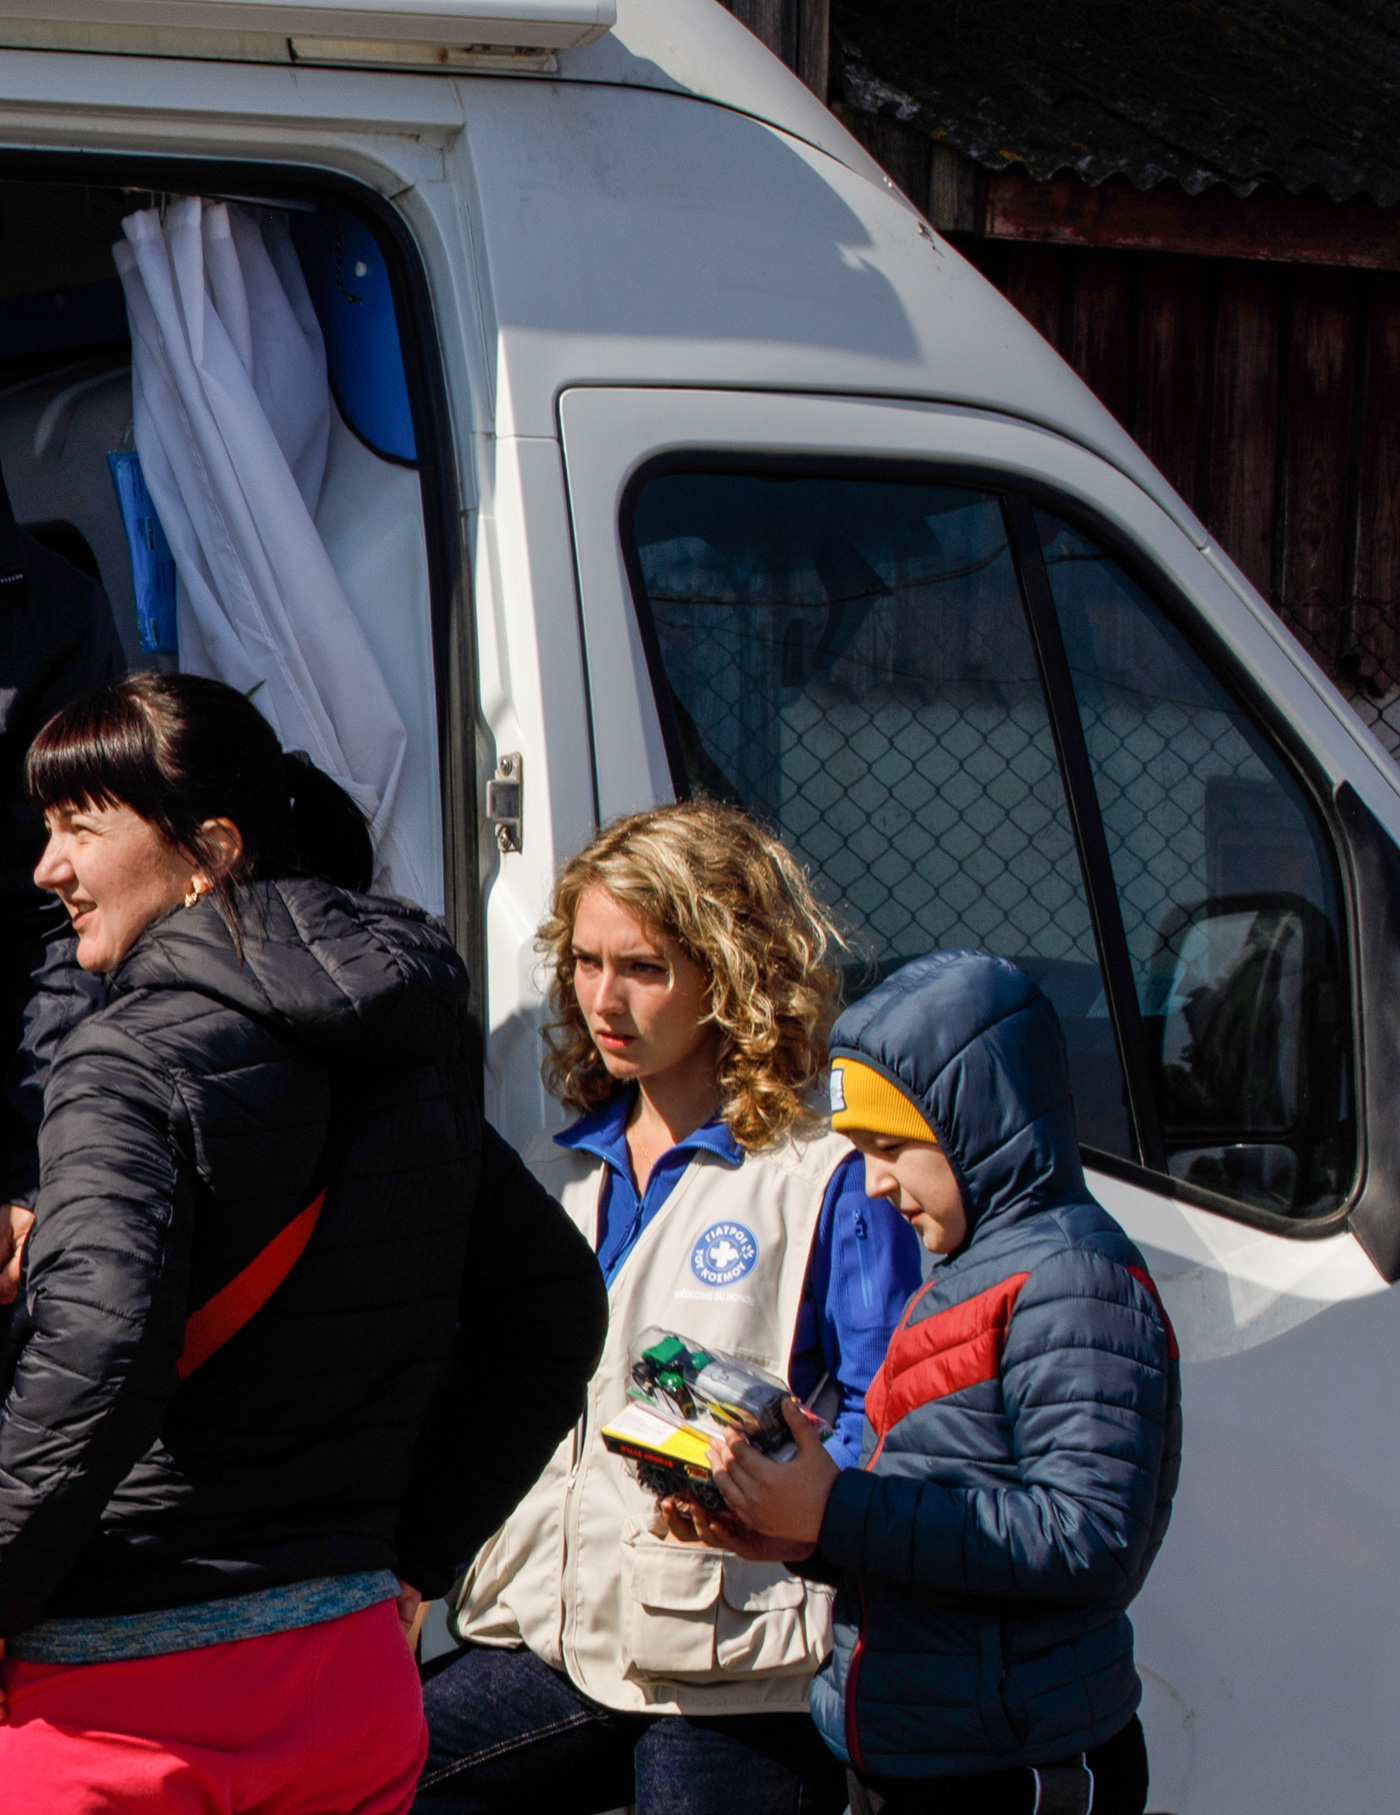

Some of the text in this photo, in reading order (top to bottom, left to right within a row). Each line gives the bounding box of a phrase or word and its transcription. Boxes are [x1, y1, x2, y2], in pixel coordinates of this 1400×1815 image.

[705, 1226, 748, 1244] ΓΙΑΤΡΟΙ
[695, 1249, 745, 1283] ΤΟΥ ΚΟΣΜΟΥ
